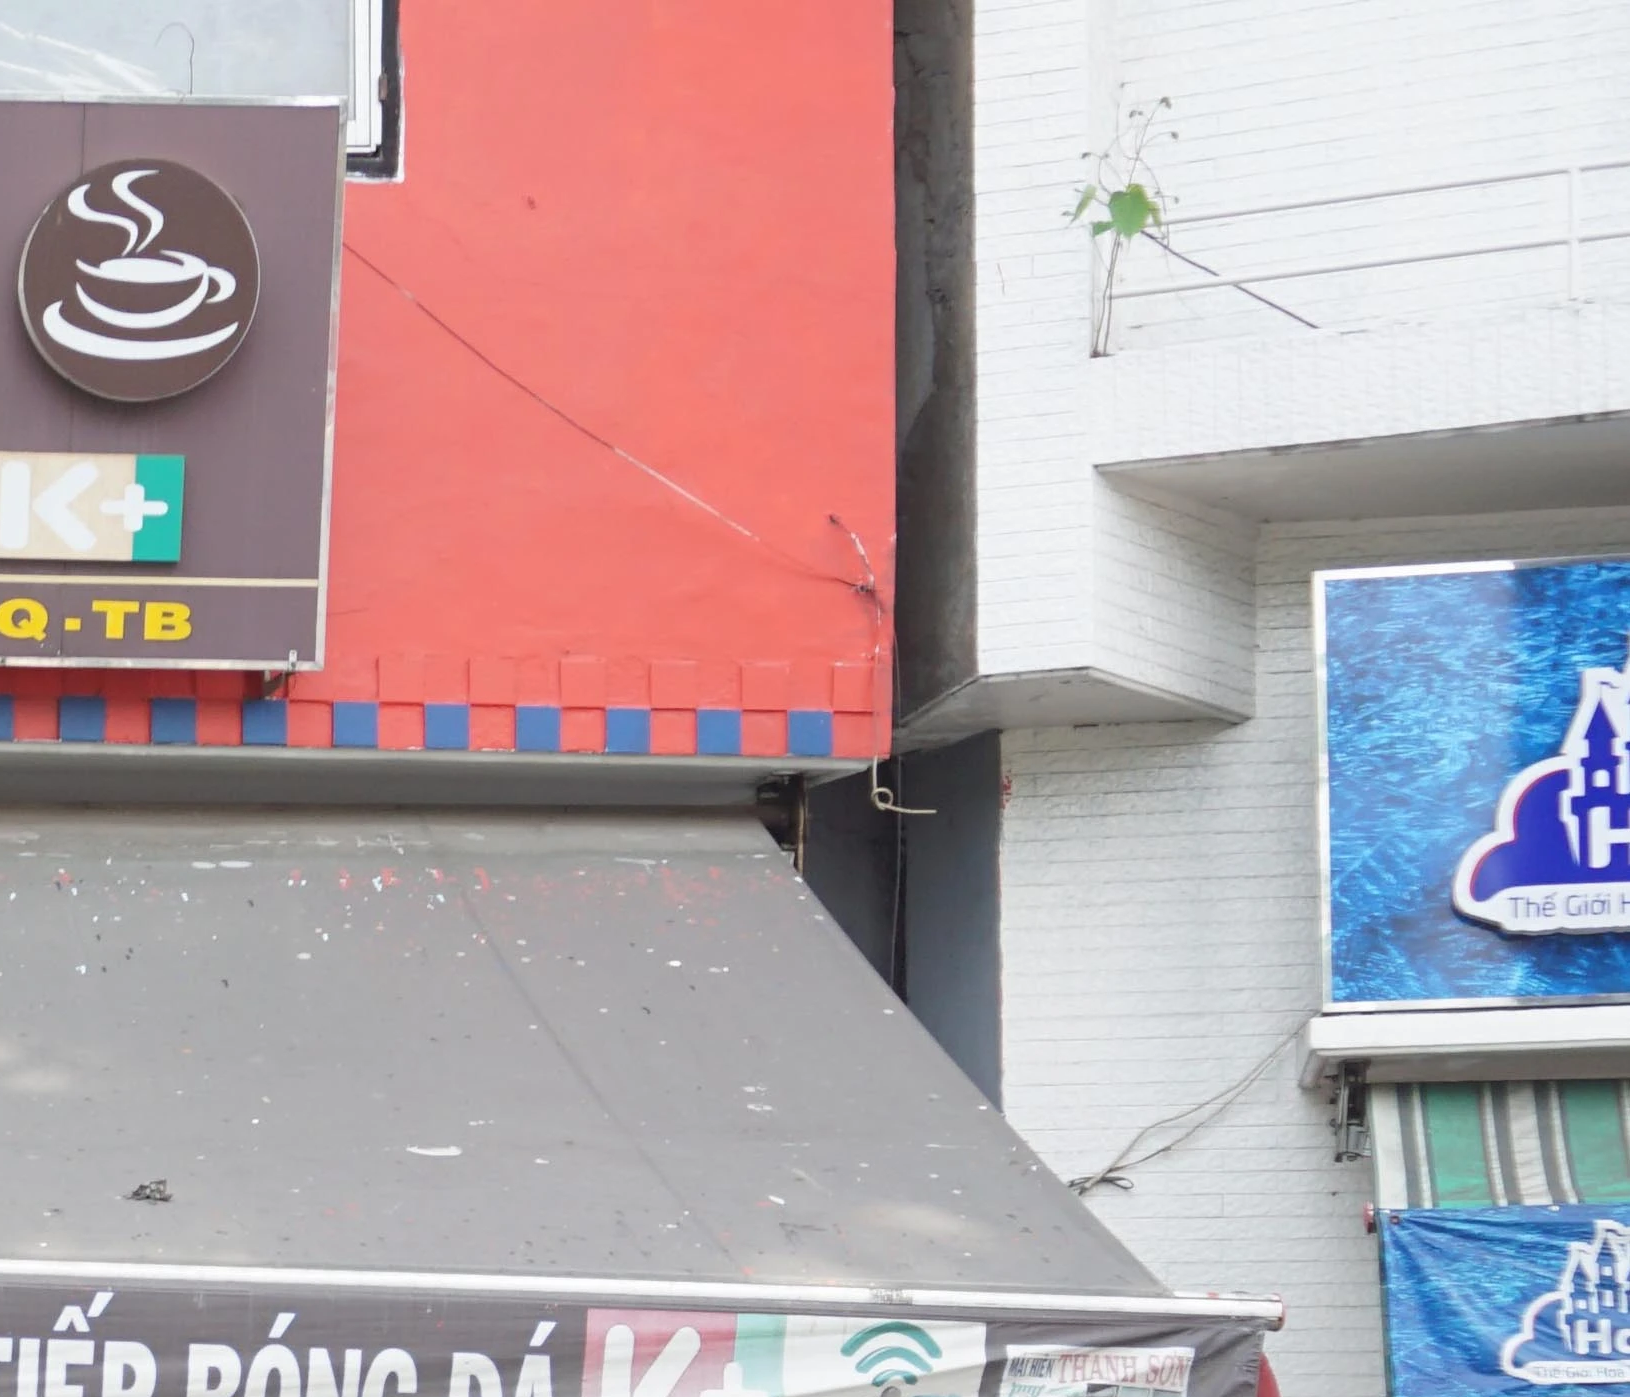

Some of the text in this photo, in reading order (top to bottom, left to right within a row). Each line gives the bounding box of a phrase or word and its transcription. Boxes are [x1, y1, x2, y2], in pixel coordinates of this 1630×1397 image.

[1507, 892, 1558, 918] Thế
[1565, 893, 1611, 916] Giới
[1059, 1354, 1137, 1383] THANH
